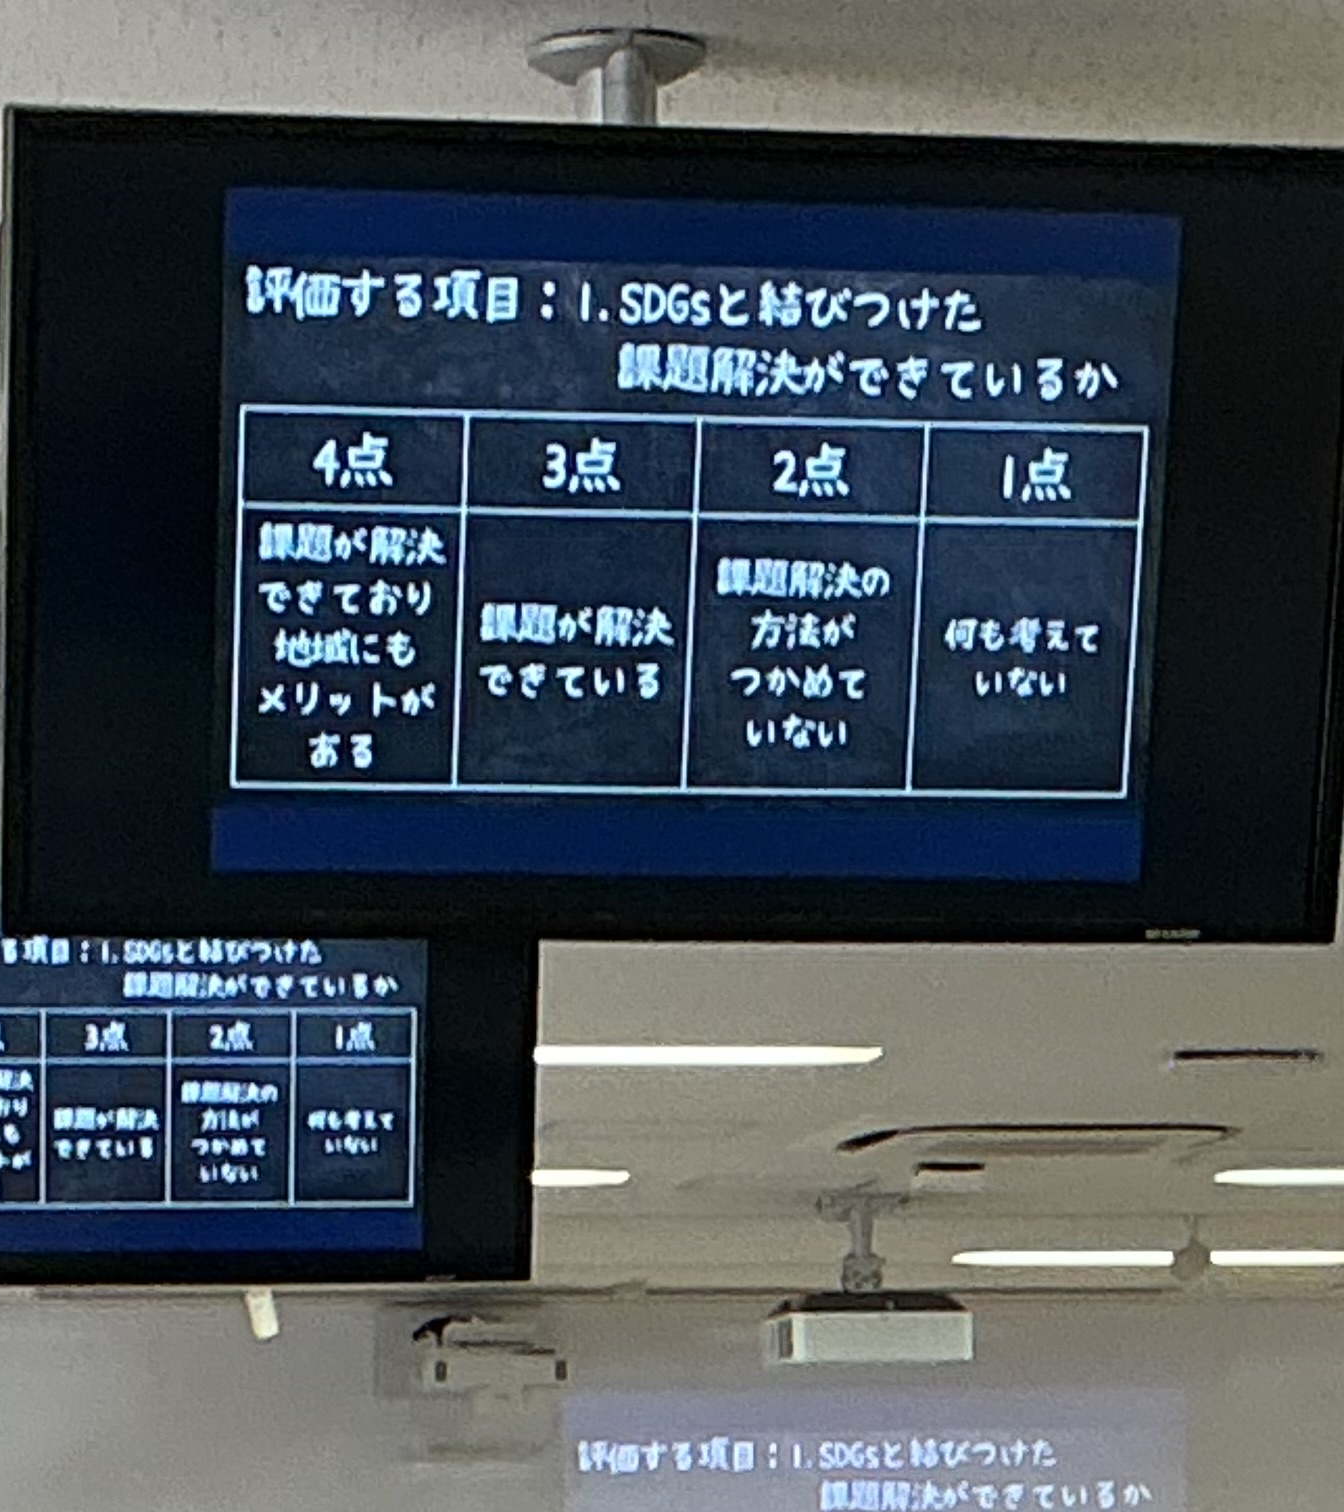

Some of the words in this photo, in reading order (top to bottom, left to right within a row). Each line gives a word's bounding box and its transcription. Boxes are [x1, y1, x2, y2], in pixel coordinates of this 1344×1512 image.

[617, 341, 1119, 401] 課題解決ができているか
[312, 431, 393, 489] 4点
[542, 437, 621, 494] 3点
[773, 441, 850, 498] 2点
[1003, 446, 1072, 503] 1点
[258, 521, 447, 566] 課題が解決
[258, 579, 432, 616] できており
[716, 557, 890, 600] 課題解決の
[479, 602, 675, 647] 課題が解決
[751, 608, 856, 650] 方法が
[944, 616, 1099, 654] 何も考えて
[273, 627, 416, 668] 地域にも
[258, 681, 436, 718] メリットが
[479, 662, 660, 700] できている
[730, 663, 866, 700] つかめて
[975, 666, 1066, 697] いない
[308, 731, 373, 769] ある
[746, 713, 847, 749] いない
